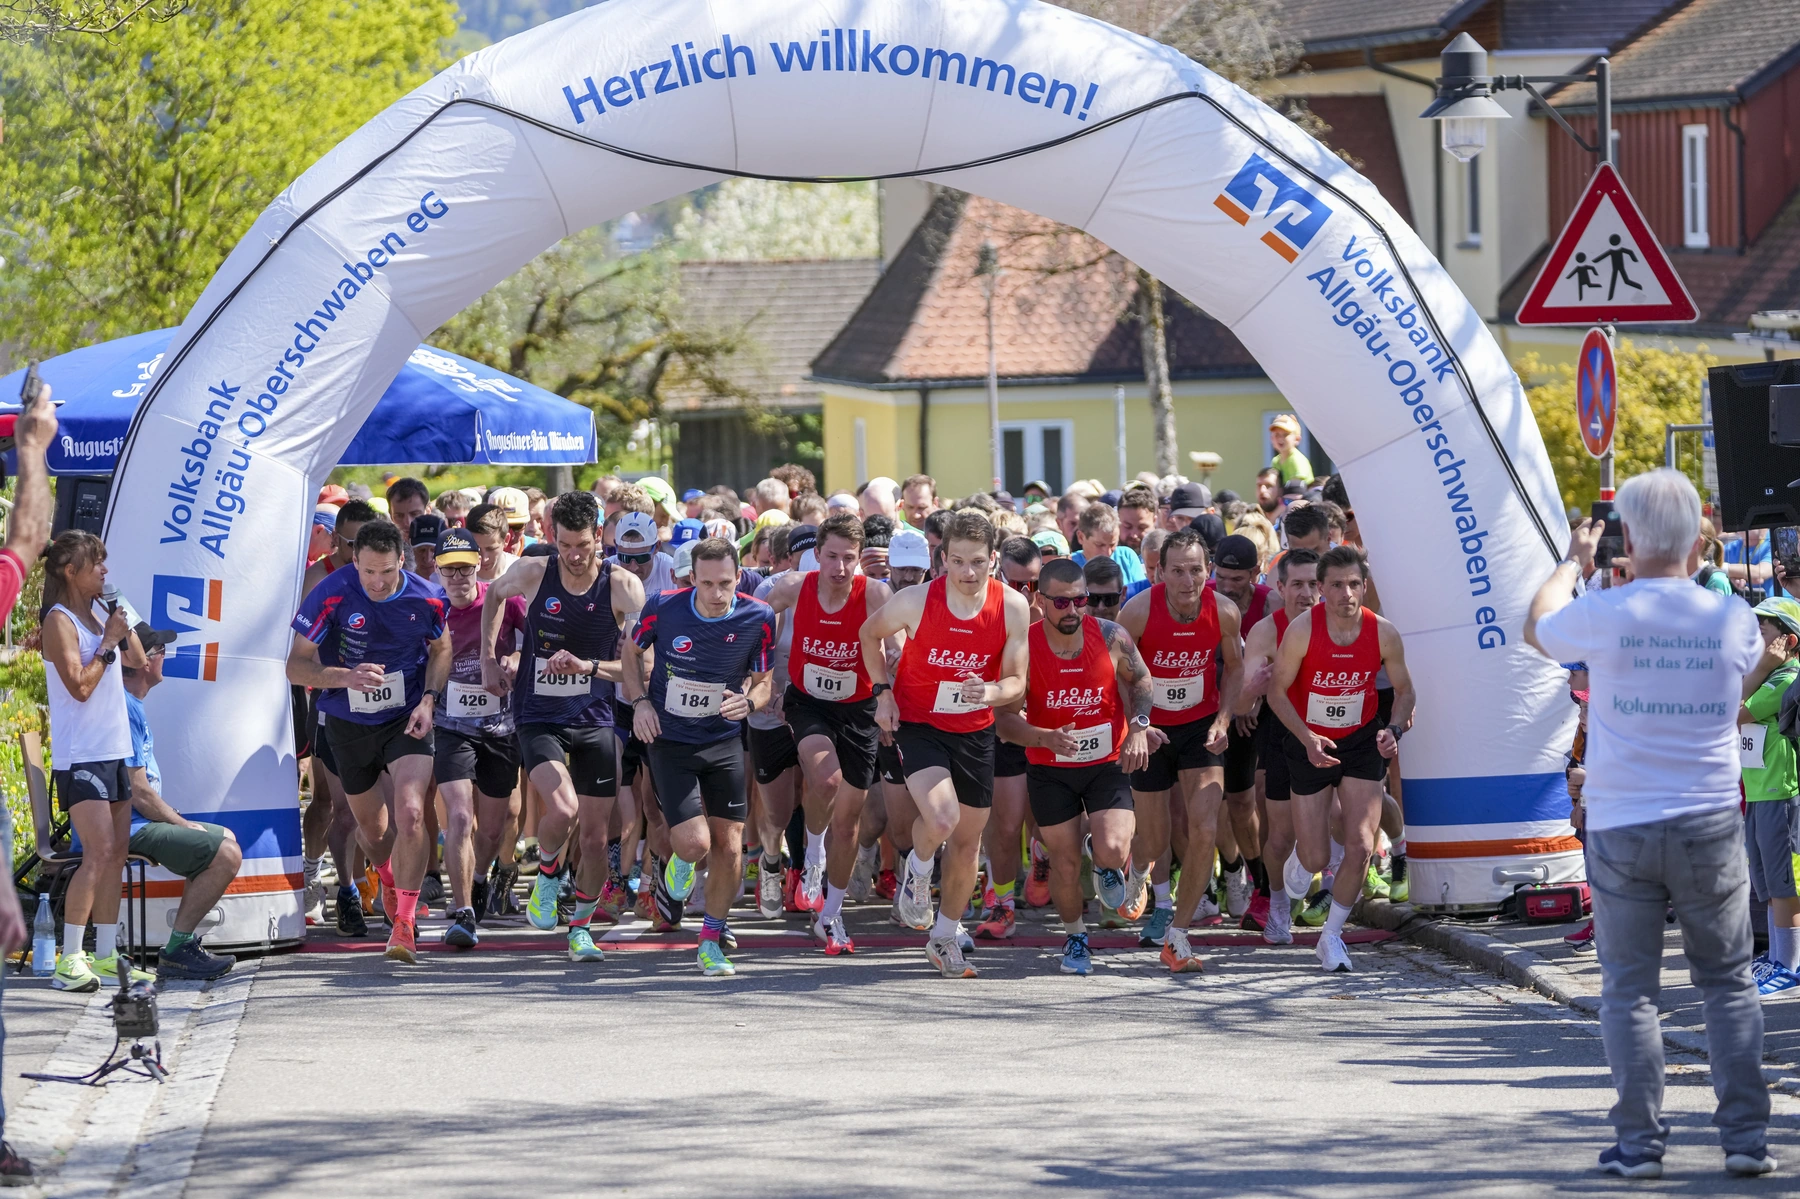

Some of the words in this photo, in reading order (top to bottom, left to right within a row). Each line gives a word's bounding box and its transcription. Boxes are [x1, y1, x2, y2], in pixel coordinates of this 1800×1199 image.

[562, 33, 756, 124] Herzlich
[769, 28, 1100, 122] willkommen!
[1342, 235, 1455, 384] Volksbank
[200, 231, 406, 560] Allgäu-Oberschwaben
[406, 190, 450, 233] eG
[160, 379, 241, 544] Volksbank
[1307, 266, 1492, 597] Allgäu-Oberschwaben
[1475, 607, 1506, 650] eG
[1620, 636, 1644, 648] Die
[1649, 635, 1722, 649] Nachricht
[803, 644, 859, 657] HASCHKO
[927, 655, 987, 668] HASCHKO
[1153, 656, 1209, 667] HASCHKO
[1634, 656, 1651, 668] ist
[1656, 656, 1681, 669] das
[1685, 657, 1714, 670] Ziel
[536, 670, 589, 686] 20913
[816, 676, 842, 691] 101
[1312, 675, 1368, 686] HASCHKO
[362, 687, 392, 703] 180
[459, 694, 488, 707] 426
[680, 692, 709, 707] 184
[1167, 688, 1186, 700] 98
[1046, 696, 1102, 708] HASCHKO
[1613, 693, 1727, 716] kolumna.org
[1326, 706, 1346, 717] 96
